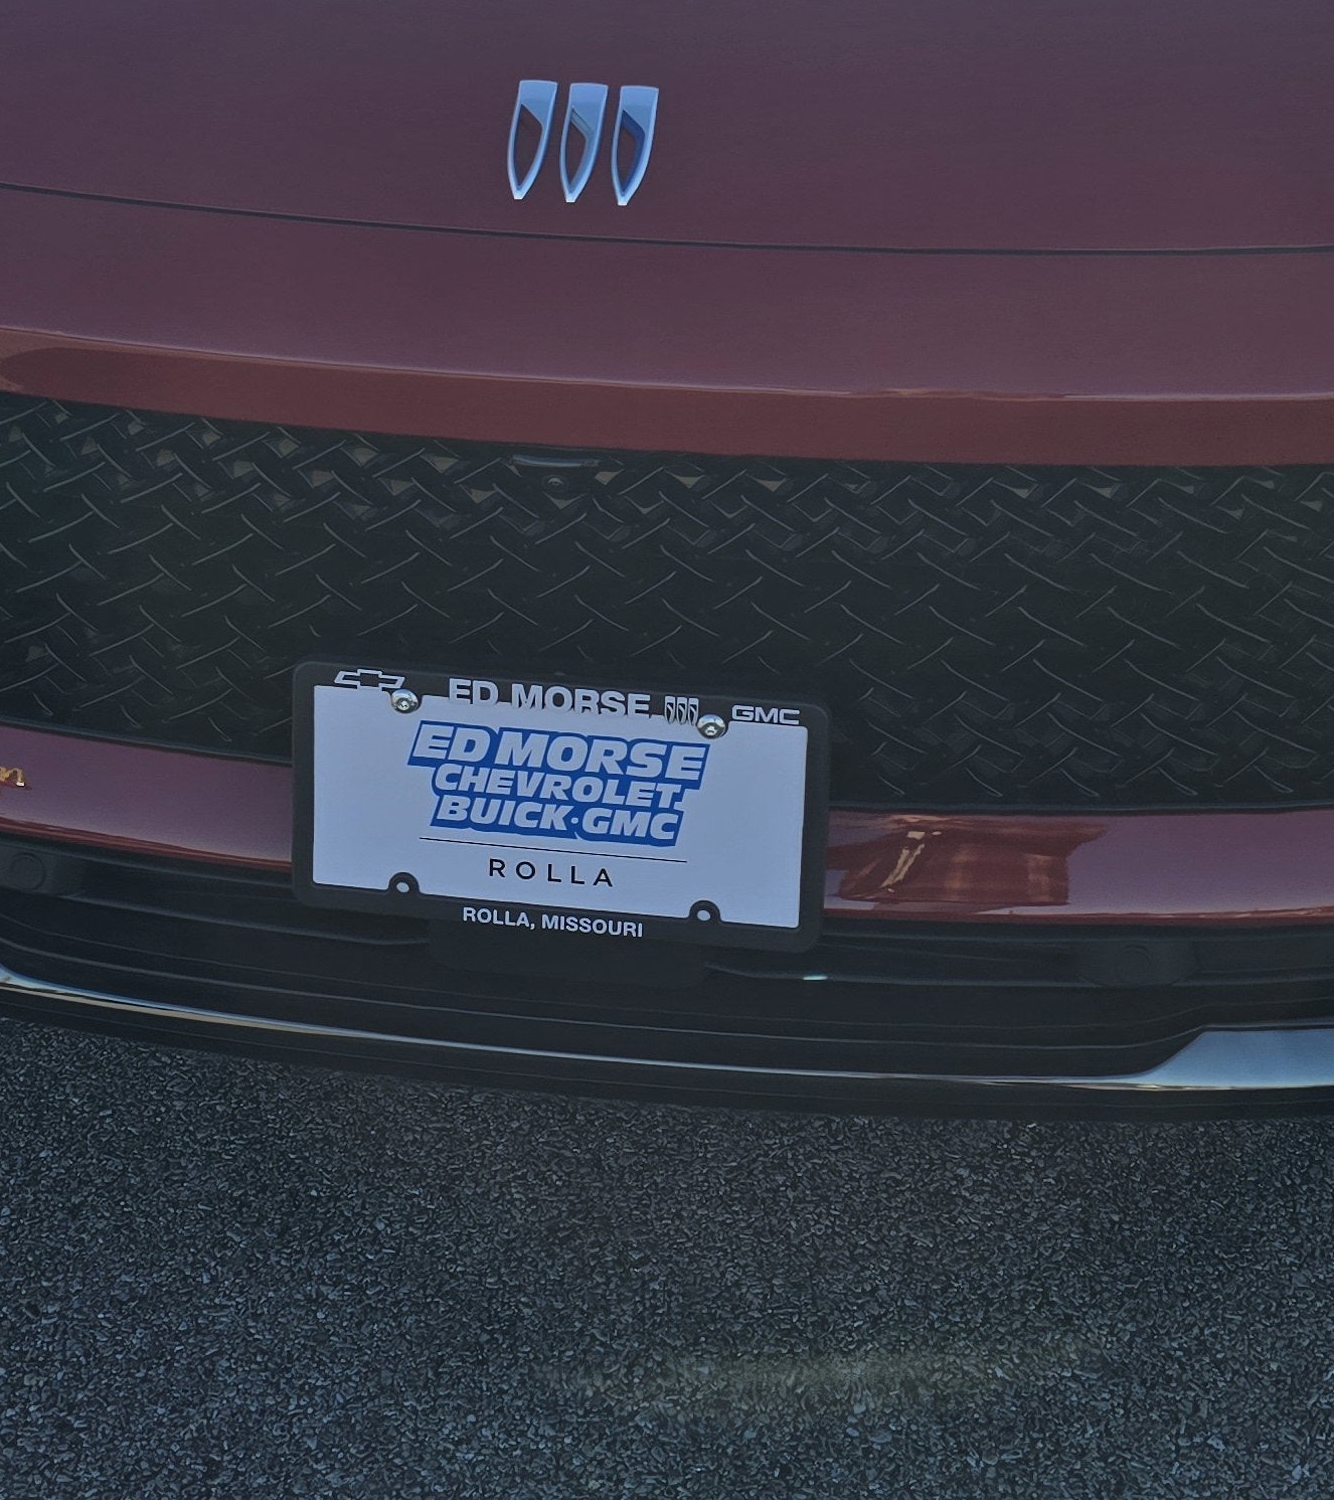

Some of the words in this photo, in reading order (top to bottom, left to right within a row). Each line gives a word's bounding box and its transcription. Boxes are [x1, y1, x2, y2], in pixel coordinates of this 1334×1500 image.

[448, 677, 499, 706] ED
[511, 683, 651, 718] MORSE
[731, 704, 801, 726] GMC
[412, 723, 491, 763] ED
[494, 730, 707, 781] MORSE
[434, 763, 683, 810] CHEVROLET
[489, 858, 613, 887] ROLLA
[463, 906, 535, 931] ROLLA,
[542, 913, 643, 938] MISSOURI
